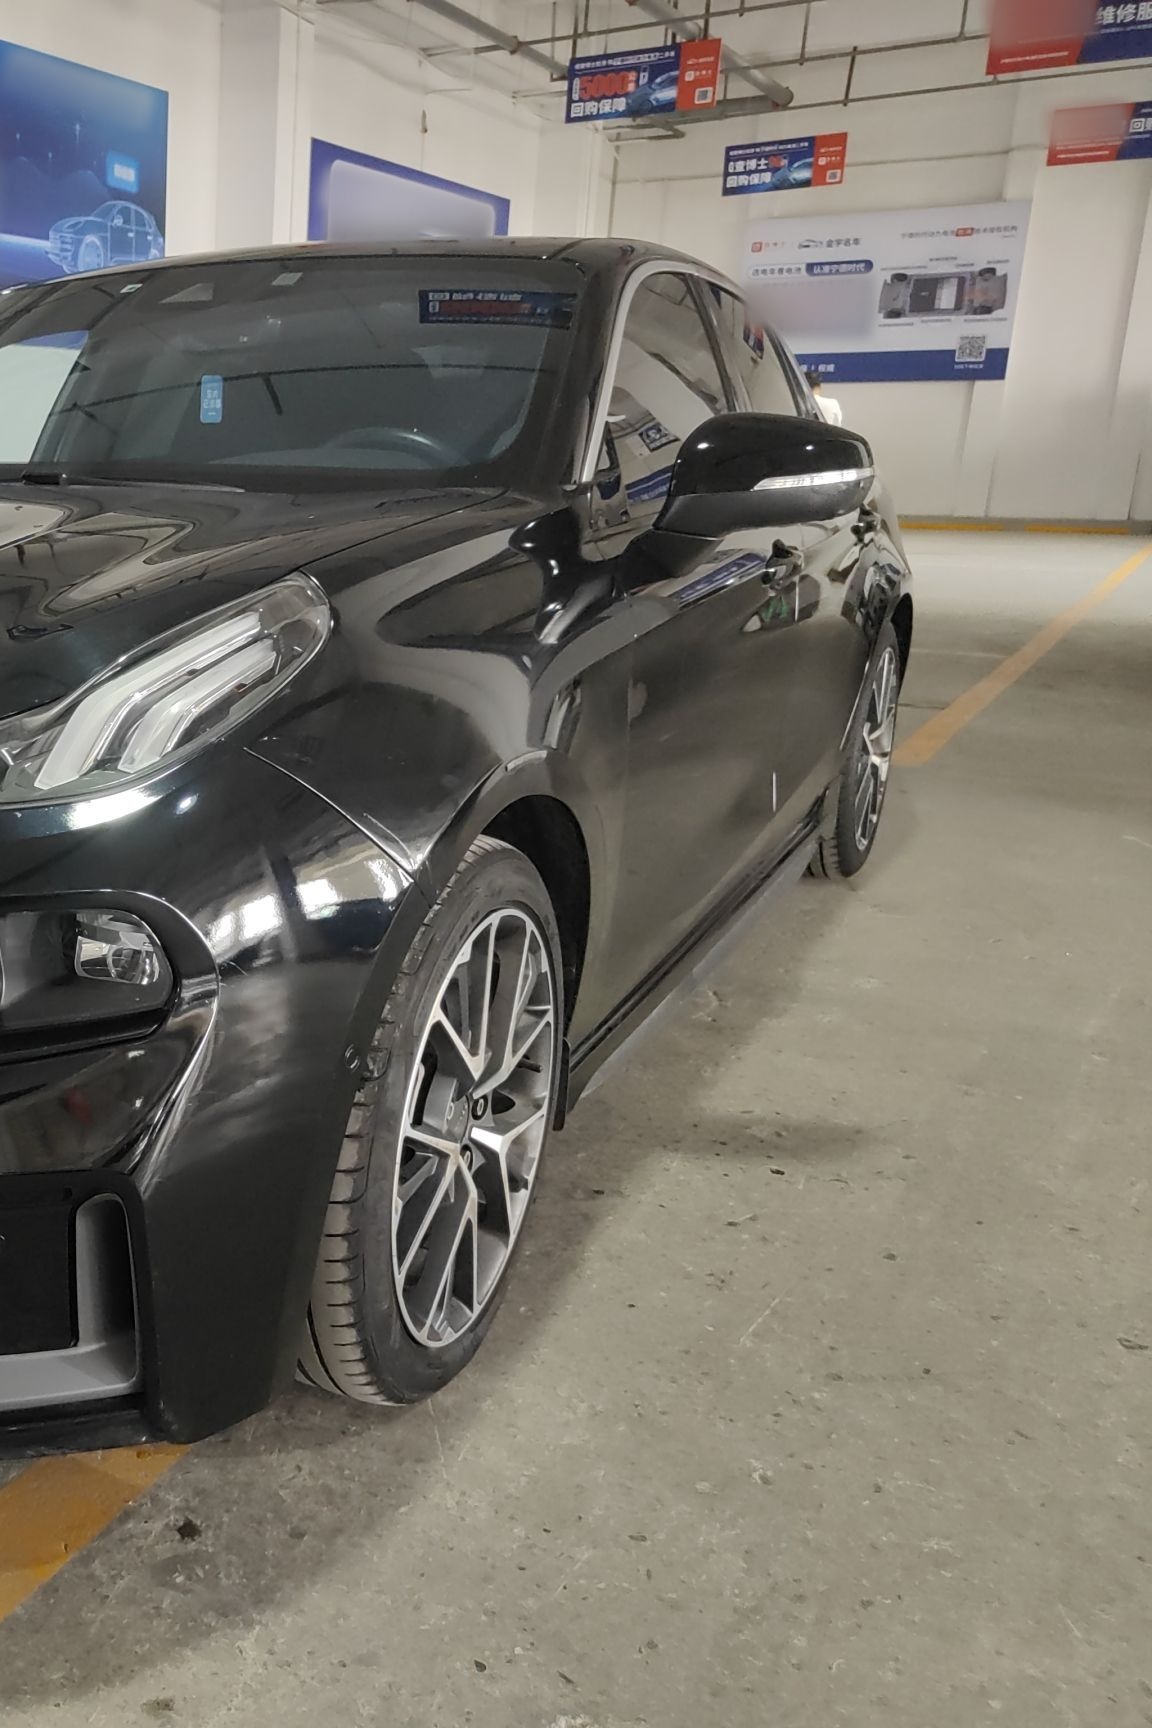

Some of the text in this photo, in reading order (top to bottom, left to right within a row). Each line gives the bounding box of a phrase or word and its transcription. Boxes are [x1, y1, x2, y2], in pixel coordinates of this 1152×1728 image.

[570, 96, 626, 118] 回购保障
[726, 172, 772, 188] 回购保障
